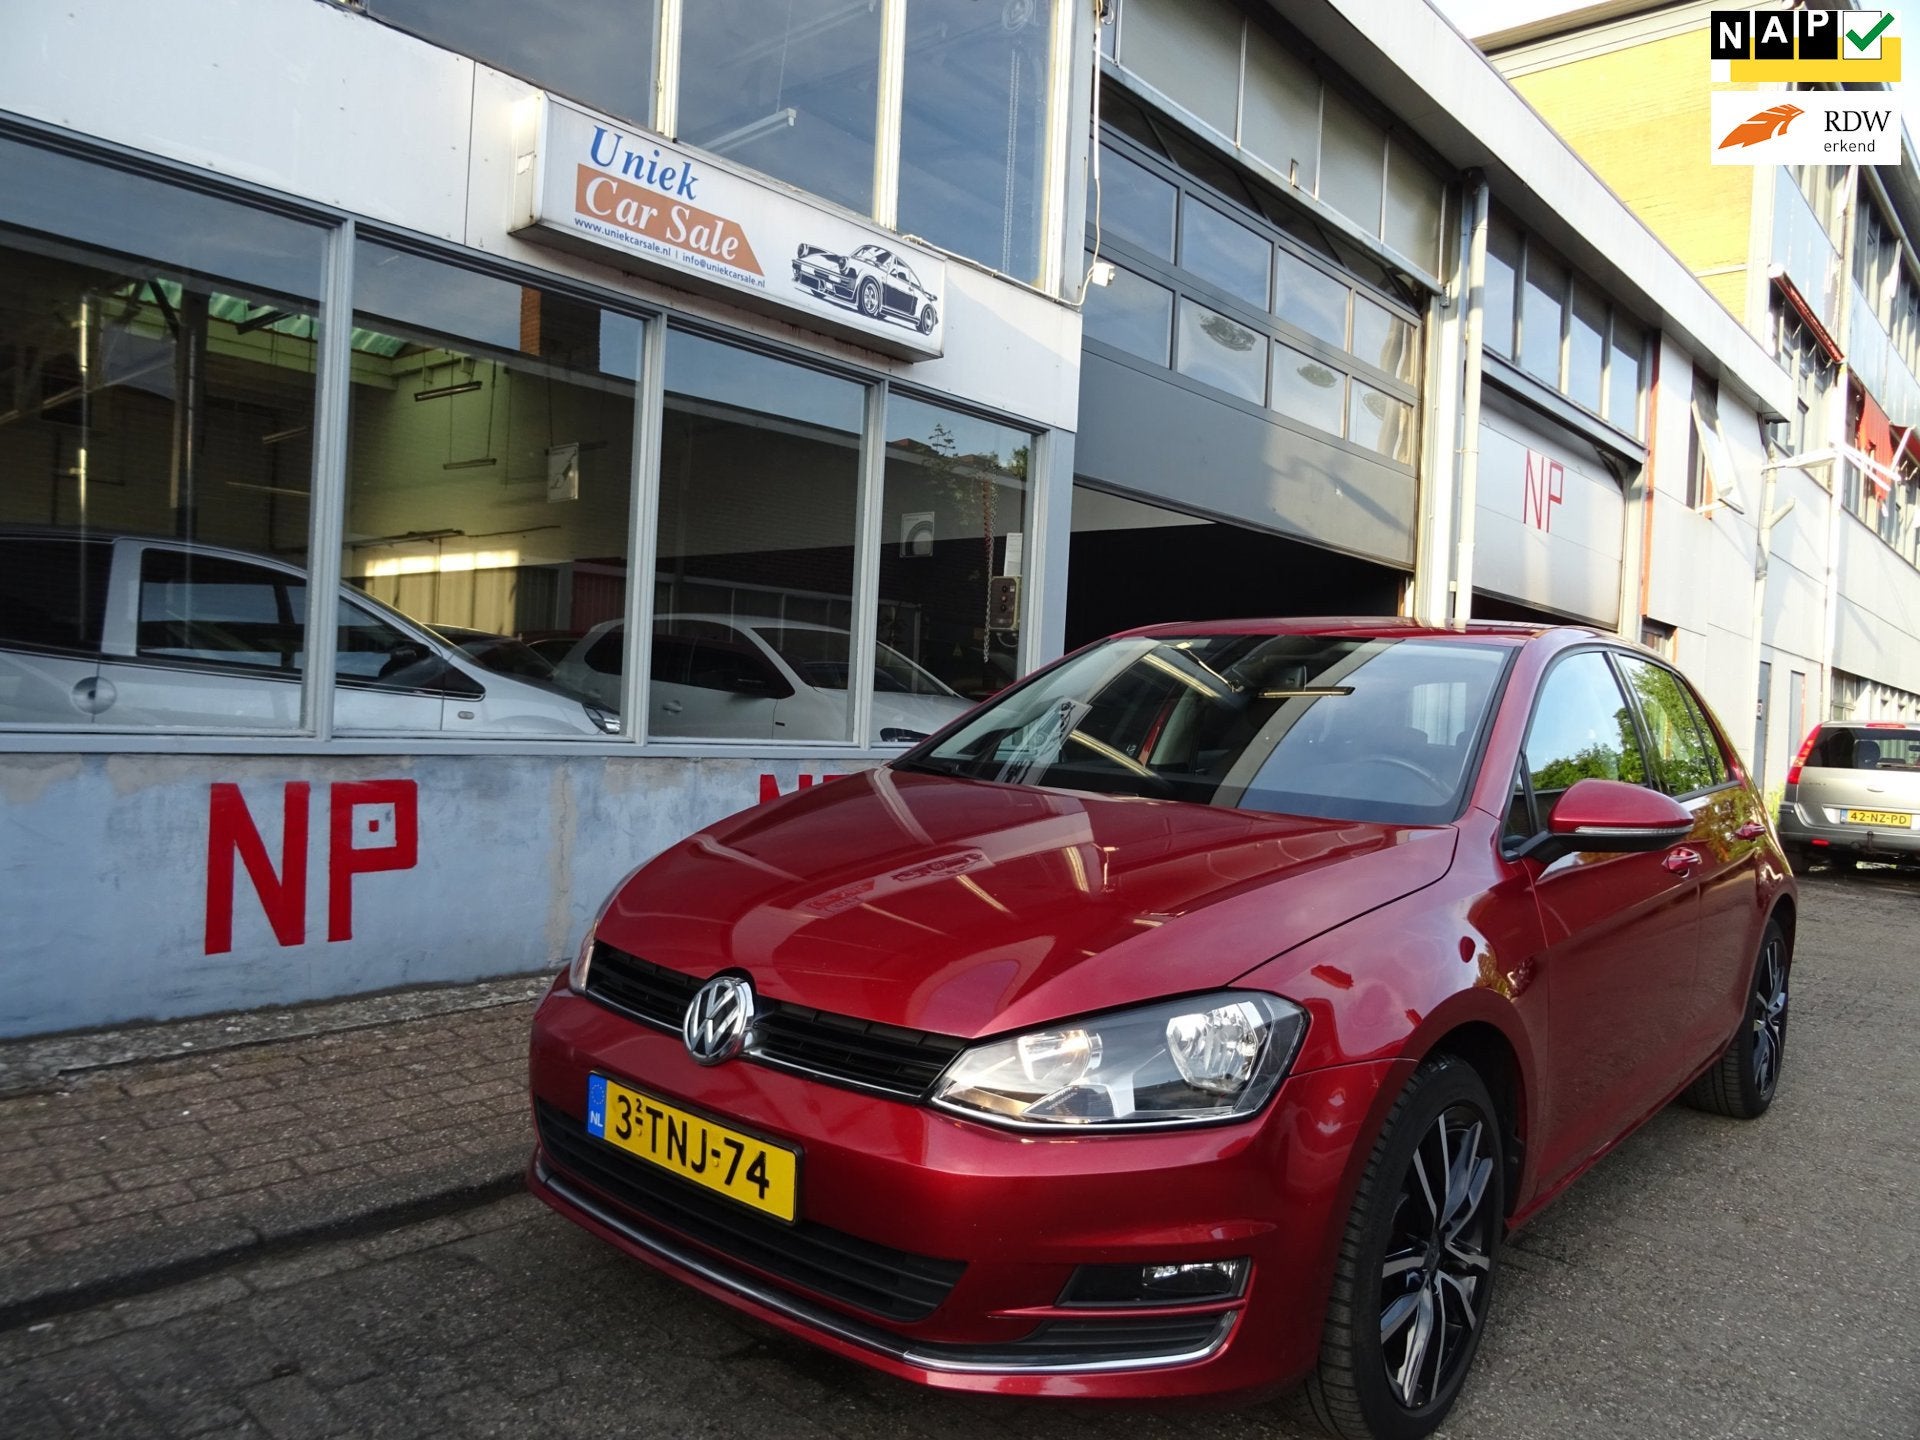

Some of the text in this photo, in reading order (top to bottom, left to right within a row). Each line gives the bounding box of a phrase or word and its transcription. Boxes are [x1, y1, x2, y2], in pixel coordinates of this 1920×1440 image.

[590, 125, 699, 200] Uniek
[574, 217, 671, 257] www.uniekcarsale.nl
[682, 252, 766, 289] info@uniekcarsale.nl
[586, 177, 739, 261] Car Sale
[1523, 449, 1564, 533] NP
[1851, 813, 1907, 825] 42-NZ-PD
[205, 779, 419, 955] NP
[590, 1110, 604, 1127] NL
